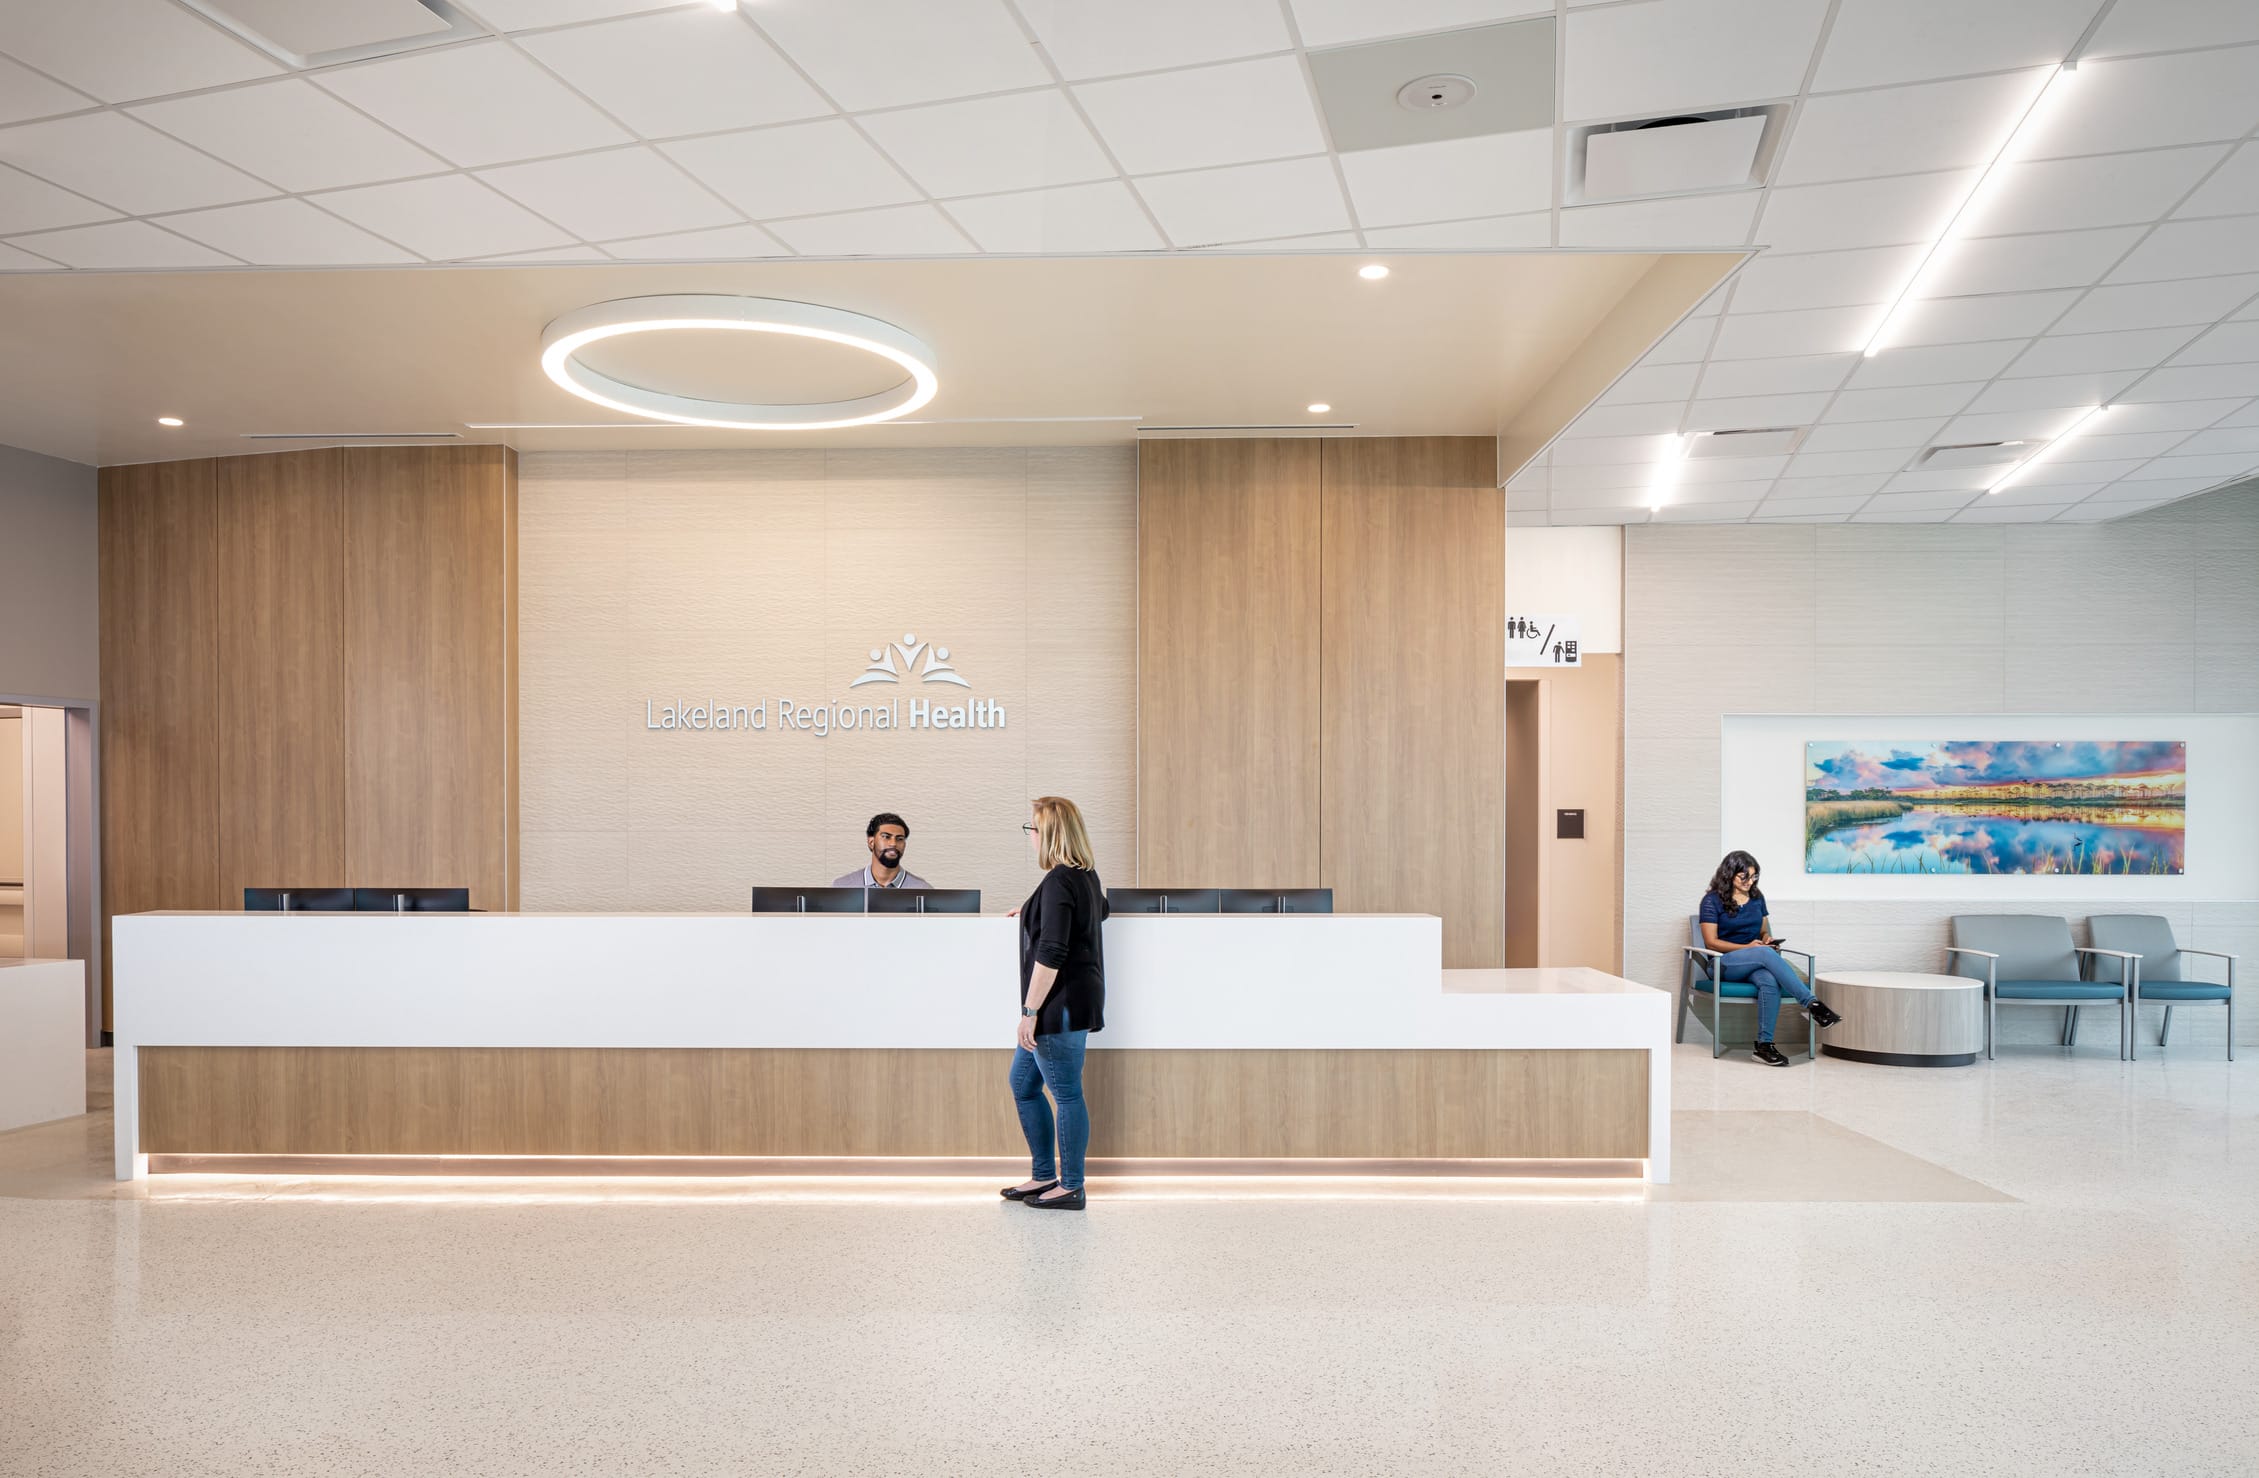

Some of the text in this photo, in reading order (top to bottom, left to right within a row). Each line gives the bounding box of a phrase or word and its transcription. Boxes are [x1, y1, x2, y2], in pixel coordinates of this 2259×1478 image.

[646, 699, 1006, 736] Lakeland Regional Health
